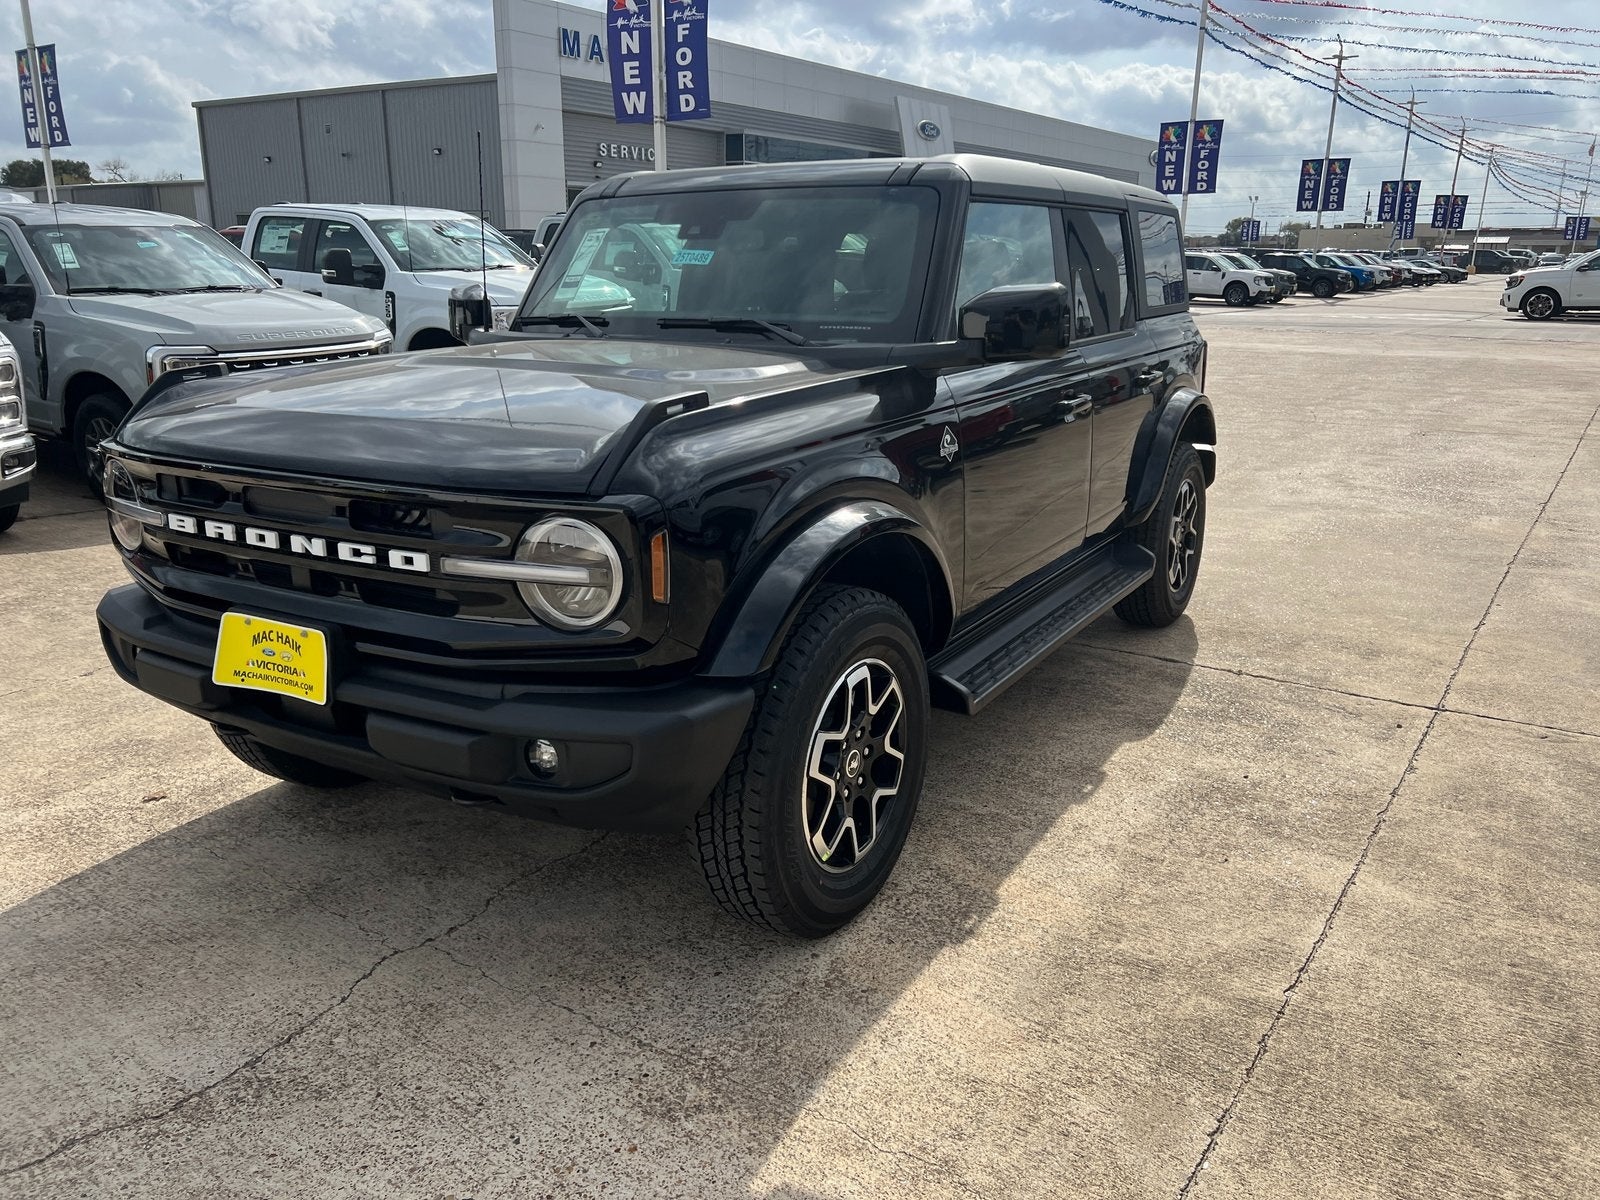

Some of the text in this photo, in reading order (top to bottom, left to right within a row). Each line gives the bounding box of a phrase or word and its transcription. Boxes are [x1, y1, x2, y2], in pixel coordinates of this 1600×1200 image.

[620, 30, 647, 115] NEW
[675, 23, 696, 113] FORD
[23, 88, 40, 143] NEW
[47, 86, 63, 142] FORD
[599, 142, 655, 161] SERVIC
[1162, 150, 1177, 191] NEW
[1196, 149, 1210, 191] FORD
[1301, 179, 1315, 209] NEW
[1328, 179, 1340, 210] FORD
[1381, 196, 1392, 220] NEW
[1403, 196, 1413, 220] FORD
[1434, 208, 1444, 227] NEW
[1452, 208, 1461, 228] FORD
[674, 252, 710, 264] 25T0489
[236, 326, 356, 342] SUPER DUTY
[168, 513, 430, 572] BRONCO
[252, 630, 302, 657] MAC HAIK
[233, 669, 314, 692] MACHAIKVICTORIA.COM
[255, 659, 299, 677] VICTORIA
